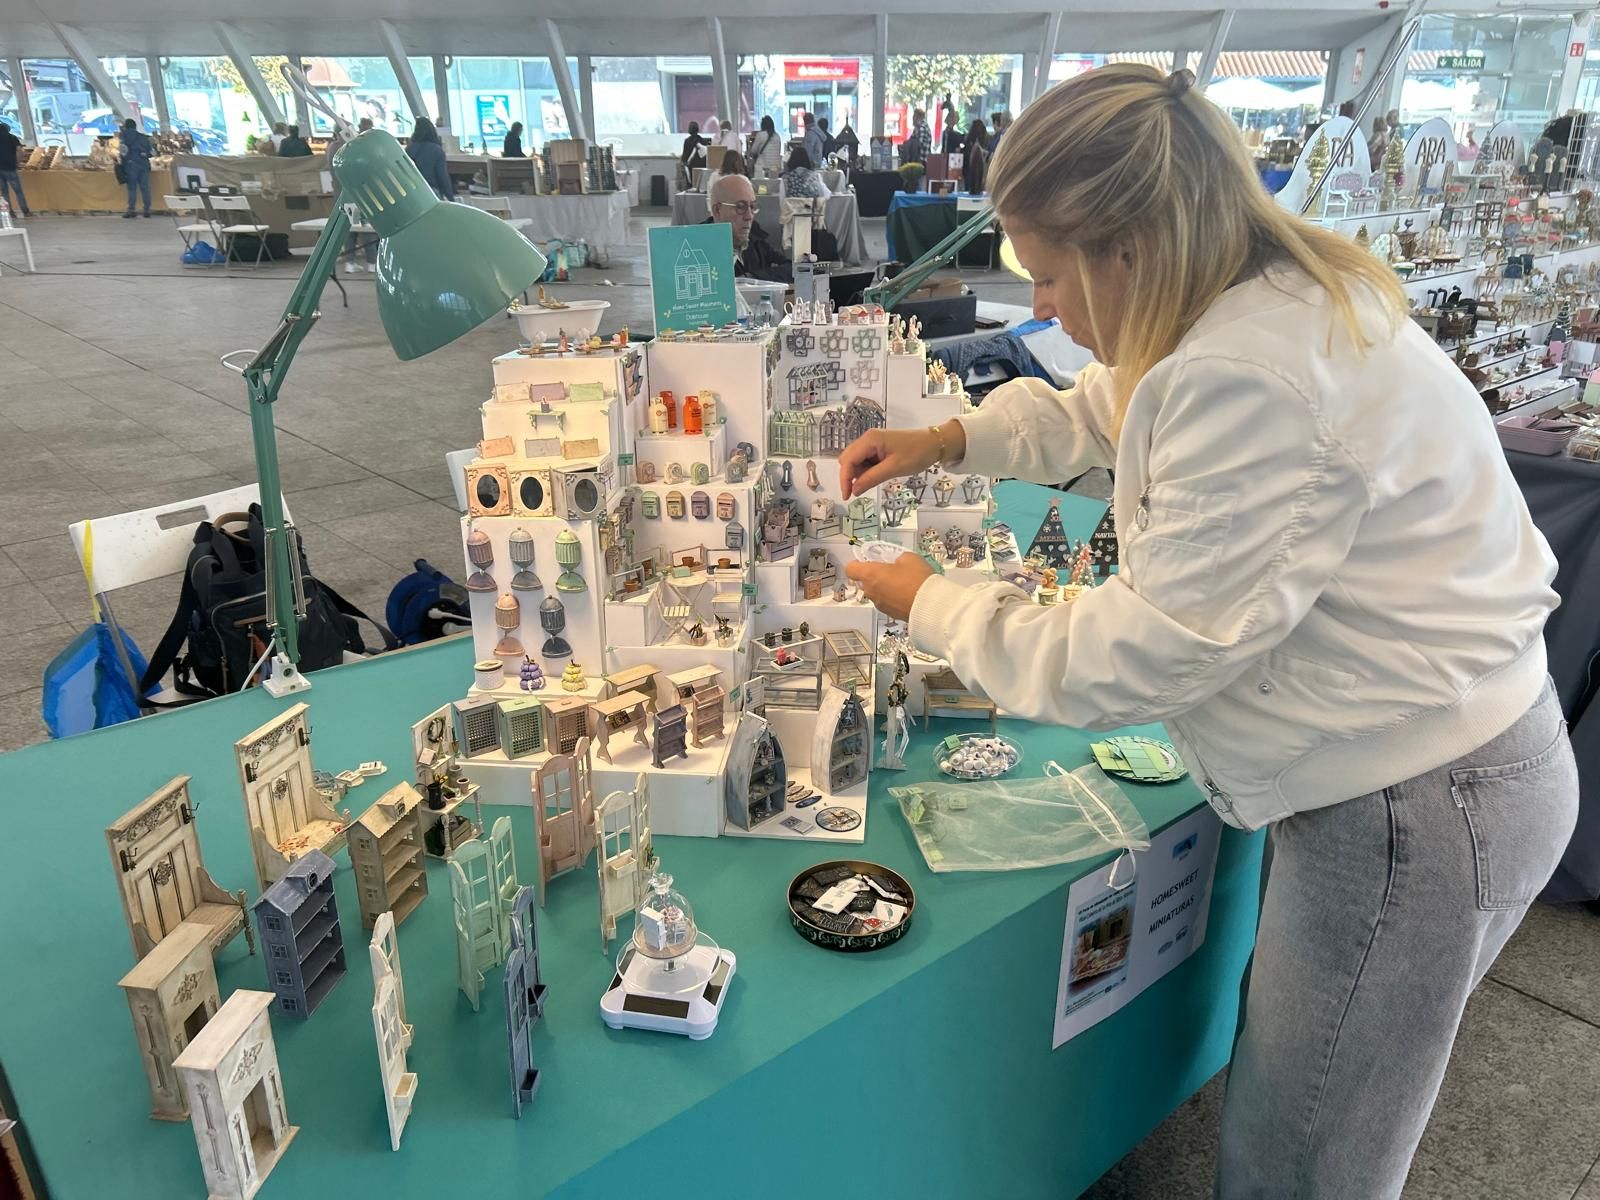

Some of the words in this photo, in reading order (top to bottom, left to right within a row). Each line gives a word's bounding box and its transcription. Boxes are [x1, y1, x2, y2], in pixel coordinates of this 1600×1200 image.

[1452, 57, 1482, 68] SALIDA
[1331, 136, 1354, 167] RA
[1414, 136, 1446, 164] ARA
[1491, 136, 1515, 161] ARA
[1151, 868, 1199, 909] HOMESWEET
[1148, 895, 1194, 934] MINIATURAS
